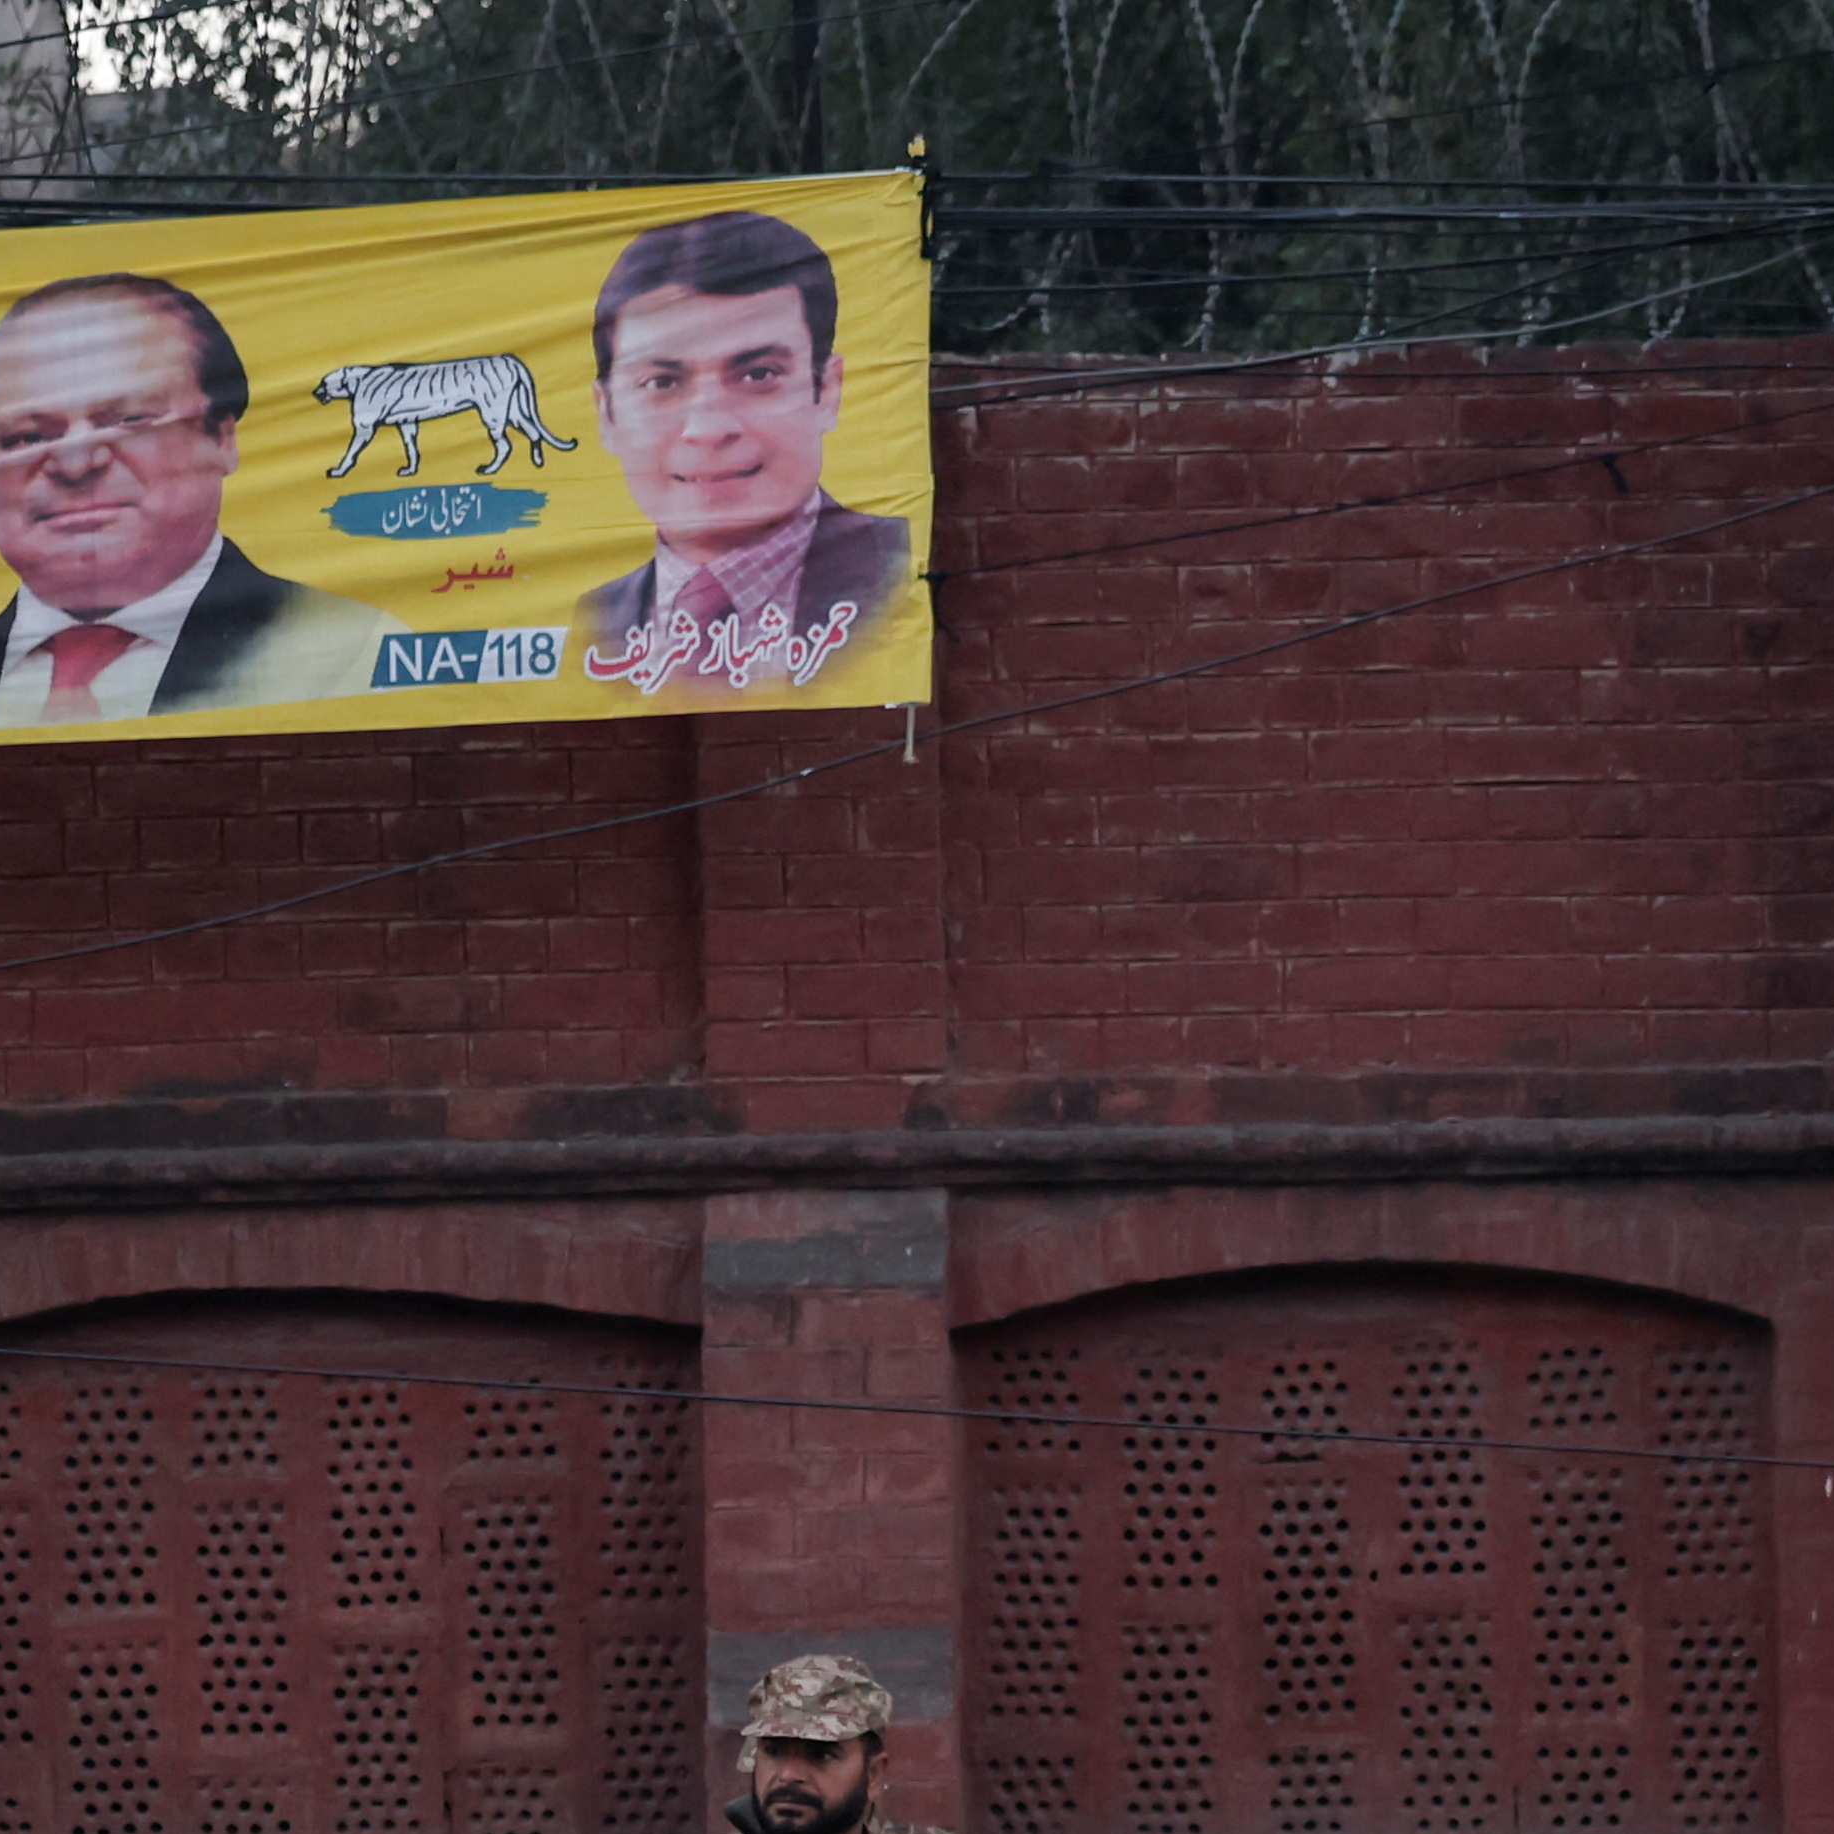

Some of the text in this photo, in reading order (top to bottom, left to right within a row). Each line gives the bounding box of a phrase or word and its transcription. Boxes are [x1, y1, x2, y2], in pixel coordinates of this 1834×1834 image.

[382, 485, 482, 534] انتخابی نشان
[431, 547, 514, 593] شیر
[389, 632, 556, 682] NA-118
[584, 609, 701, 694] شریف
